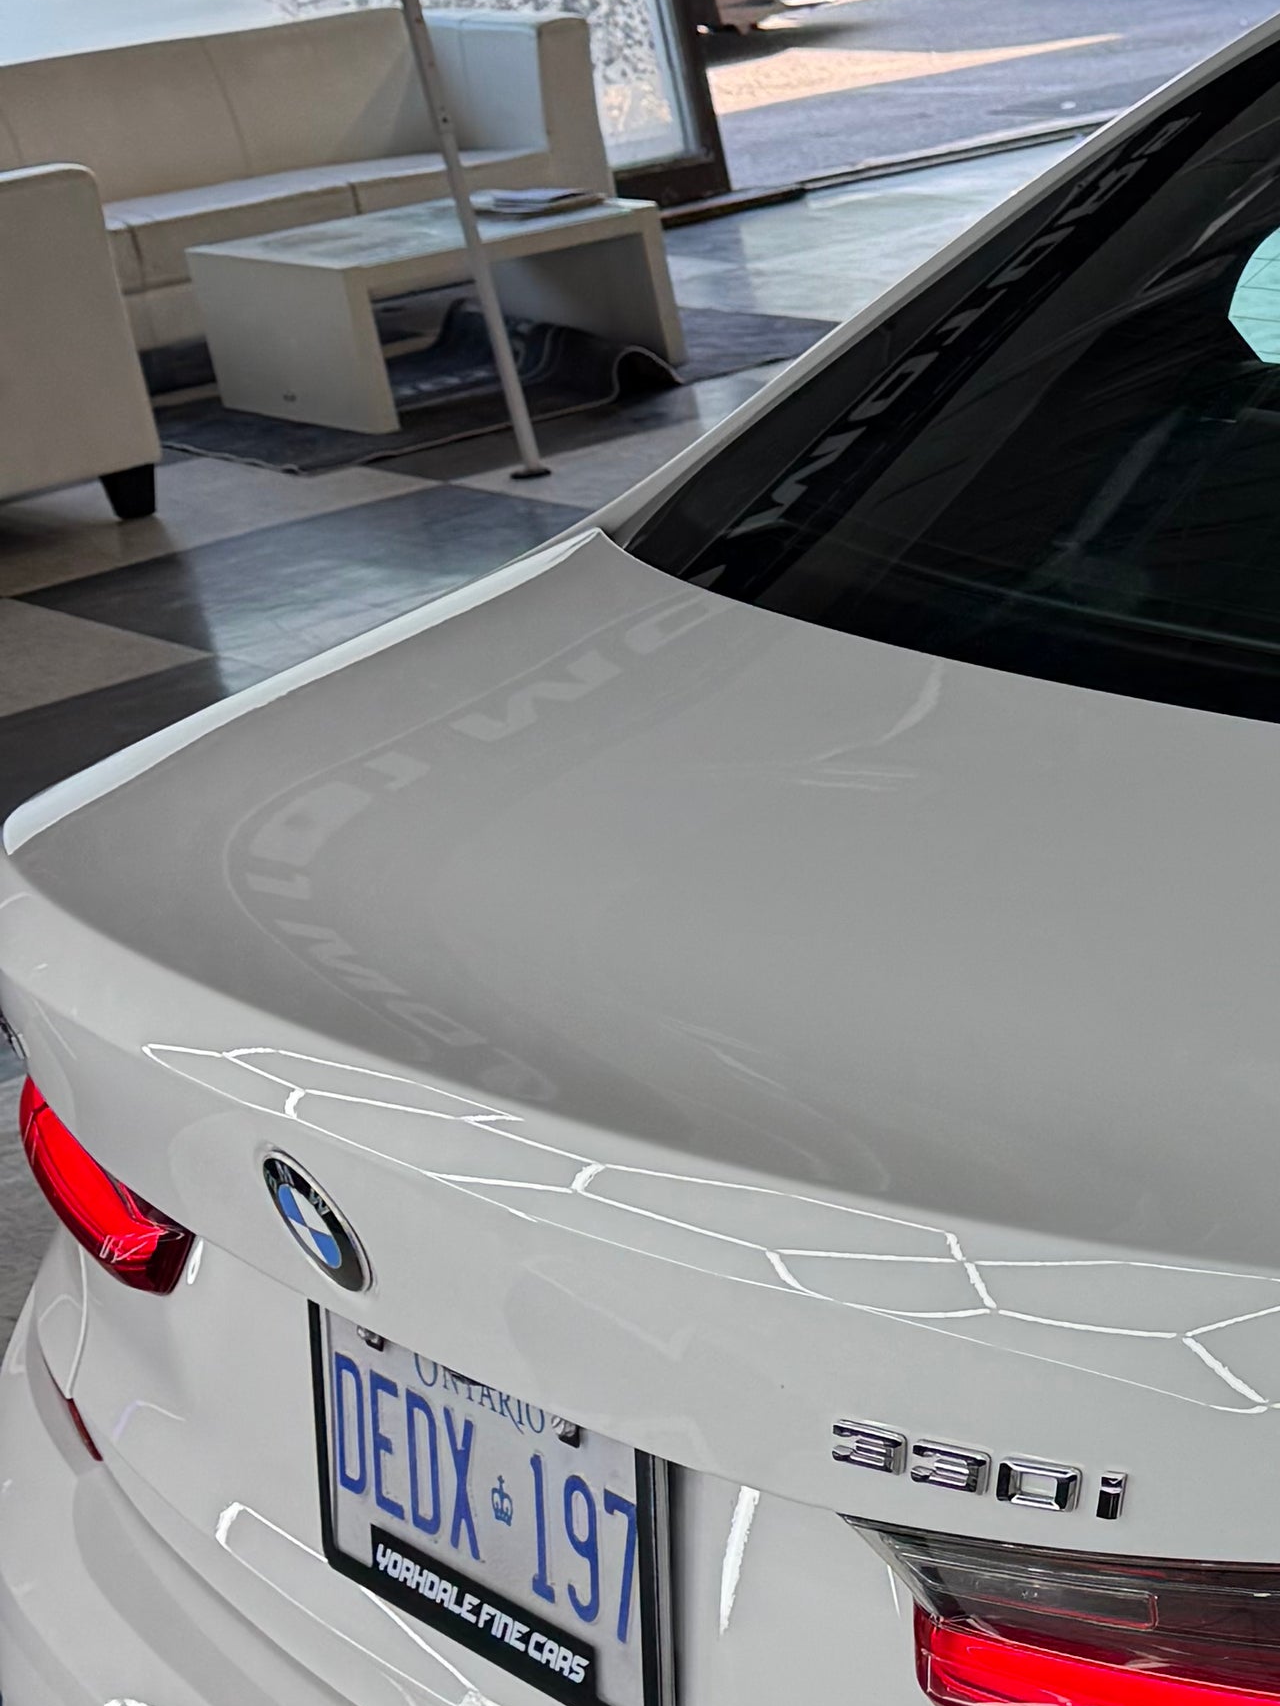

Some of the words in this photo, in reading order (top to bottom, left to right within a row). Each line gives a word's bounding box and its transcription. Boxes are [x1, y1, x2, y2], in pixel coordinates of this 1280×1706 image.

[335, 1352, 480, 1561] DEDX
[530, 1454, 638, 1643] 197
[832, 1419, 1129, 1520] 330i
[478, 1603, 530, 1652] FINE
[528, 1632, 589, 1684] CARS
